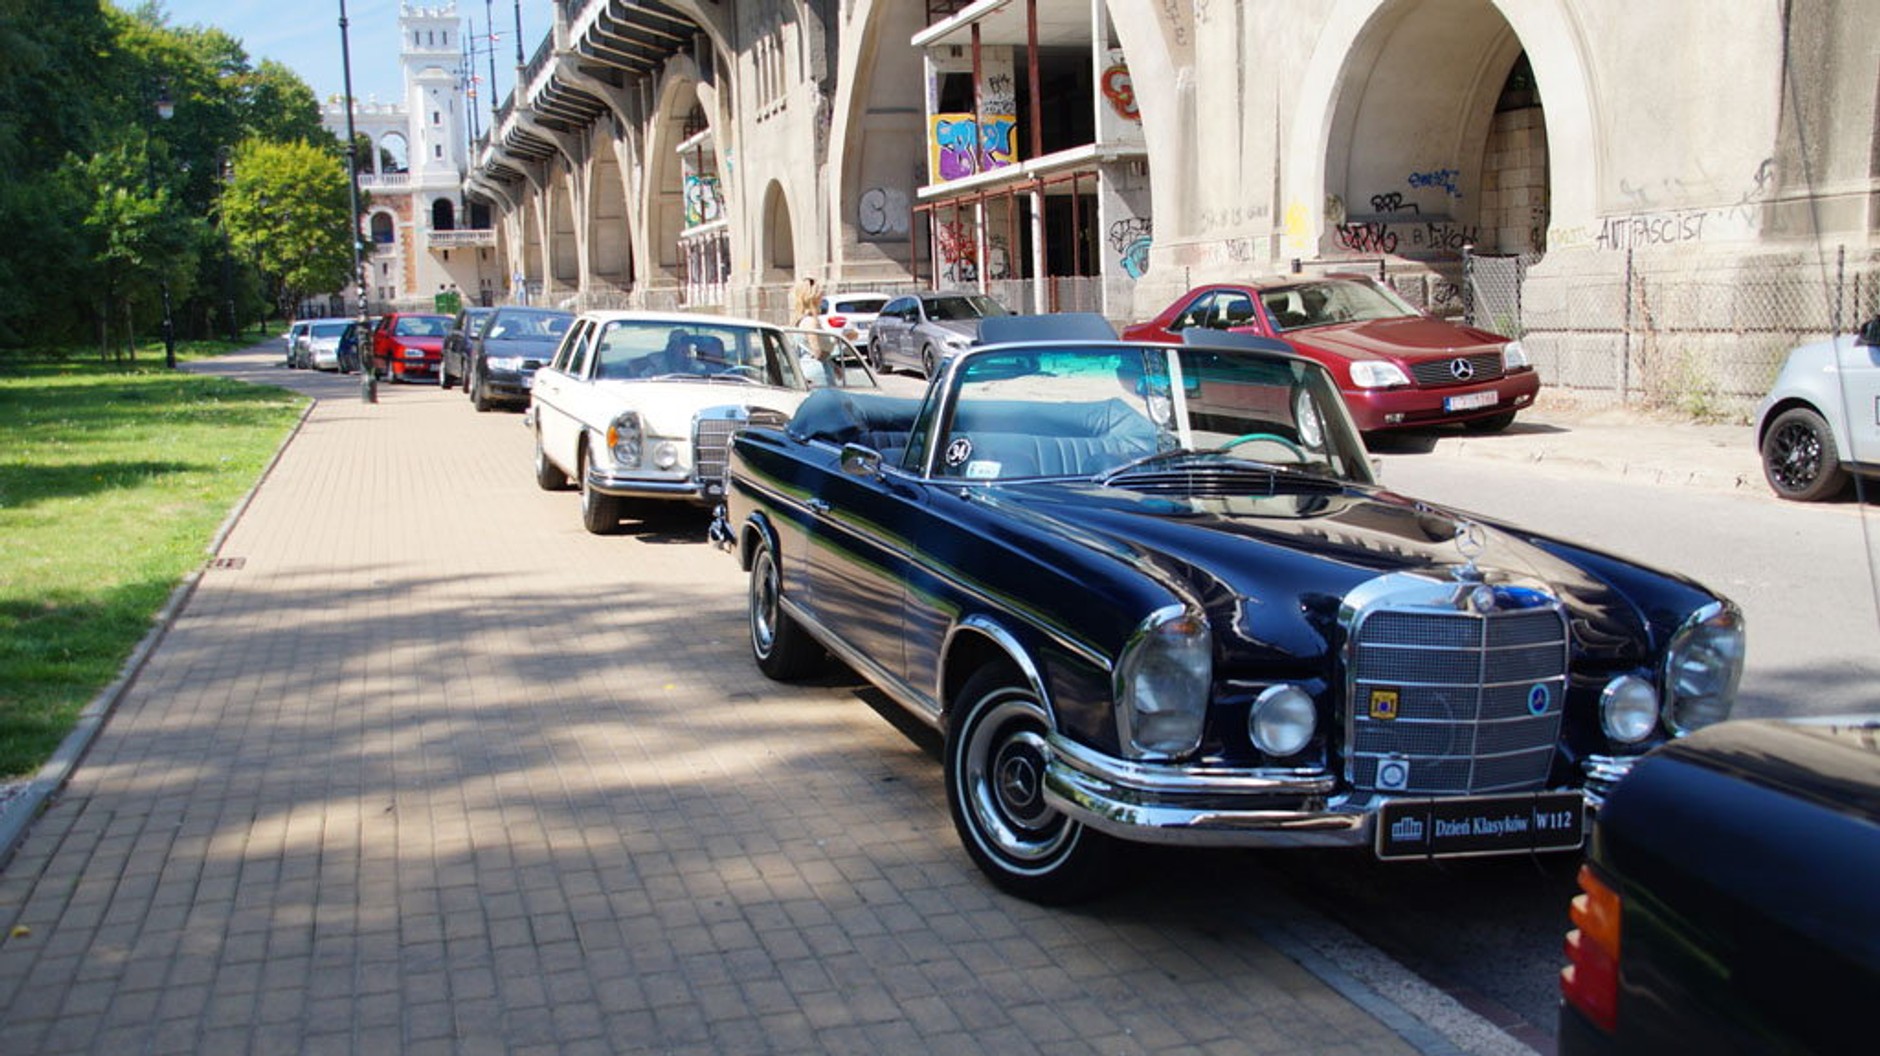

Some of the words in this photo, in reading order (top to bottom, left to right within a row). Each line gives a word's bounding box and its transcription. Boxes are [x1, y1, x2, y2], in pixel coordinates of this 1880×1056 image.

[1435, 817, 1470, 837] Dzień
[1472, 814, 1529, 836] Klasyków
[1536, 813, 1549, 829] W
[1550, 811, 1572, 829] 112
